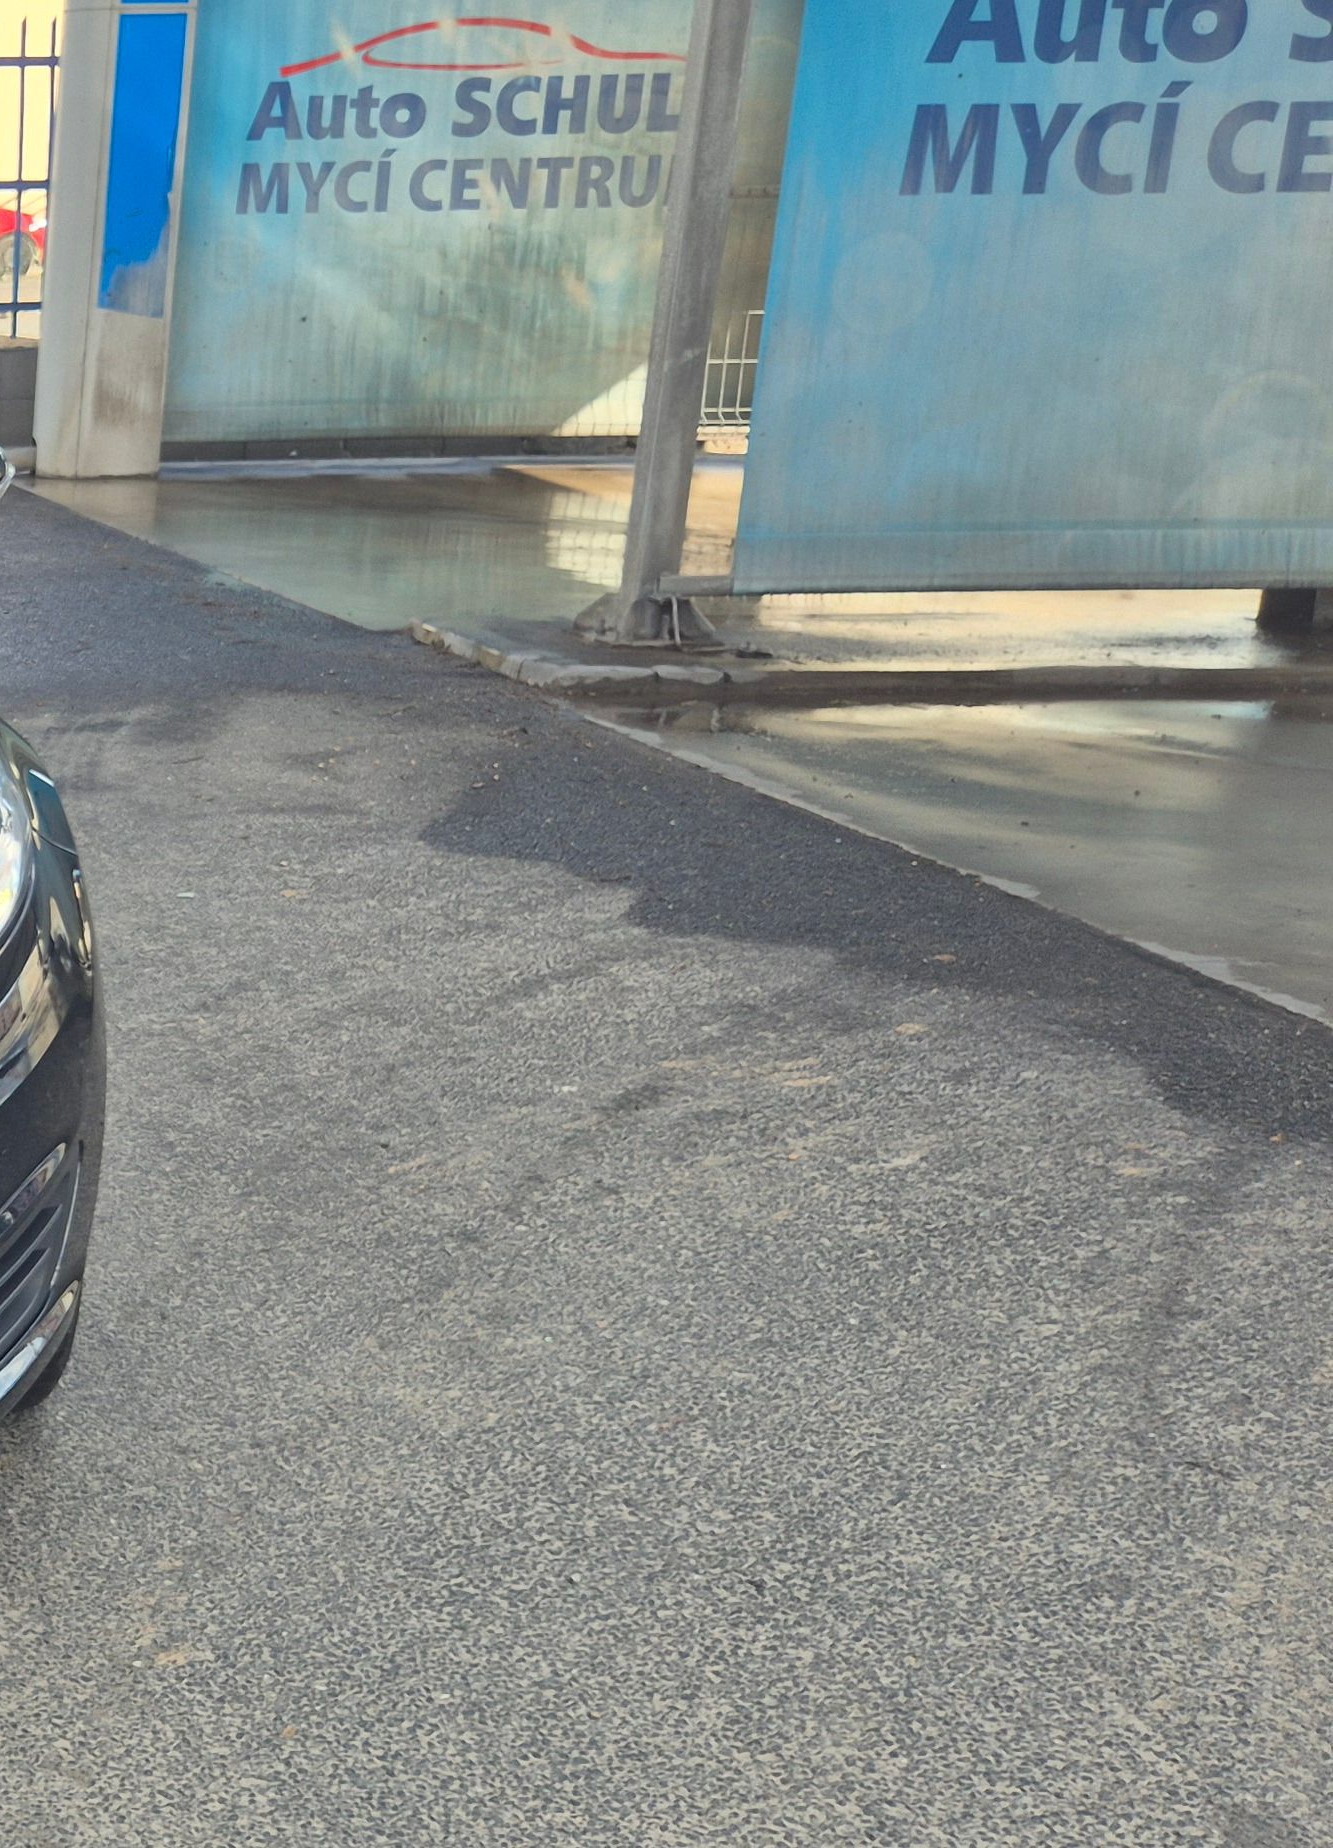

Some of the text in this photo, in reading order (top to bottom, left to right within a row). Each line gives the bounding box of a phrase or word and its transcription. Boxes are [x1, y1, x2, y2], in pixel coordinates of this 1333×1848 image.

[924, 0, 1248, 63] Auto
[246, 80, 427, 141] Auto
[899, 81, 1193, 196] MYCÍ
[235, 148, 676, 214] MYCÍ CENTRU
